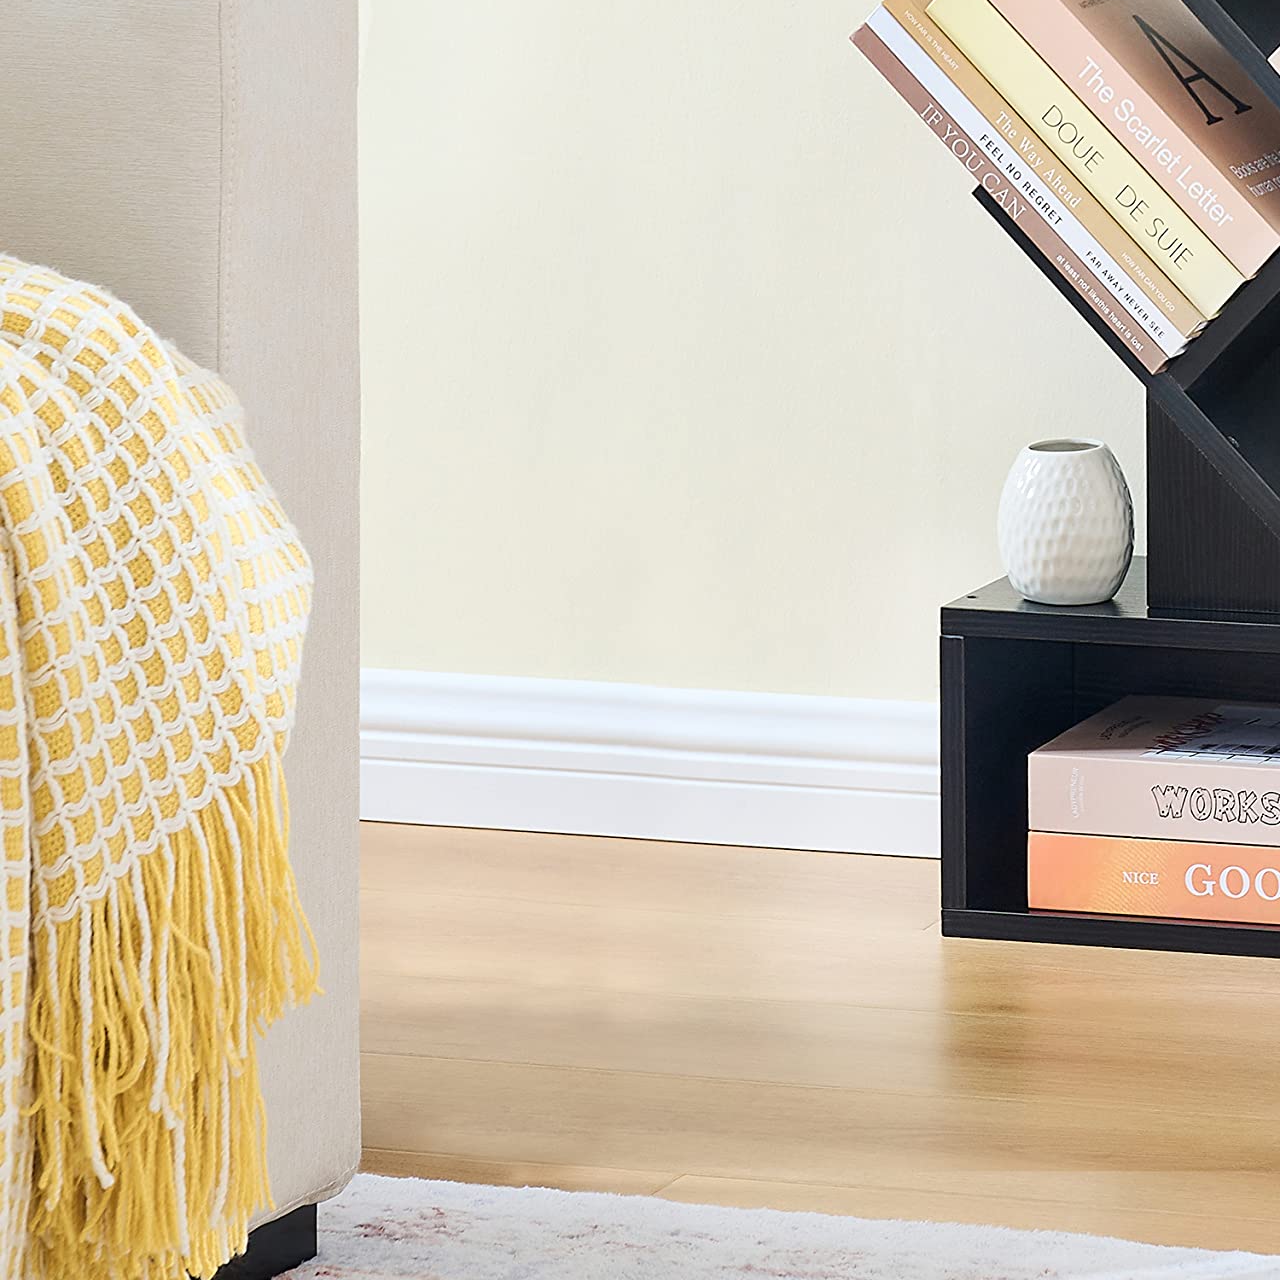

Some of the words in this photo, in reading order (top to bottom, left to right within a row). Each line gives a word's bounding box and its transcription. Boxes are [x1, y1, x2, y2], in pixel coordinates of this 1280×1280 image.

[903, 10, 919, 27] HOW
[915, 23, 929, 38] FAR
[940, 50, 958, 71] HEART
[1132, 14, 1254, 126] A
[917, 102, 944, 129] IF
[936, 123, 985, 176] YOU
[978, 171, 1027, 222] CAN
[979, 134, 1004, 163] FEEL
[1005, 163, 1022, 181] NO
[1022, 181, 1063, 225] REGRET
[994, 110, 1018, 140] The
[1013, 136, 1045, 173] Way
[1042, 166, 1082, 209] Ahead
[1040, 104, 1105, 173] DOUE
[1114, 184, 1150, 222] DE
[1144, 217, 1195, 270] SUIE
[1076, 55, 1116, 104] The
[1113, 96, 1185, 175] Scarlet
[1175, 164, 1235, 228] Letter
[1229, 162, 1259, 179] Books
[1055, 253, 1066, 265] at
[1061, 261, 1081, 282] least
[1077, 278, 1091, 293] not
[1107, 311, 1128, 333] heart
[1123, 329, 1134, 340] is
[1129, 336, 1145, 353] lost
[1085, 250, 1102, 269] FAR
[1101, 269, 1124, 292] AWAY
[1124, 293, 1149, 321] NEVER
[1150, 321, 1164, 337] SEE
[1120, 251, 1137, 269] HOW
[1132, 265, 1147, 280] FAR
[1142, 276, 1158, 292] CAN
[1153, 288, 1167, 303] YOU
[1164, 300, 1177, 313] GO
[1122, 871, 1159, 885] NICE
